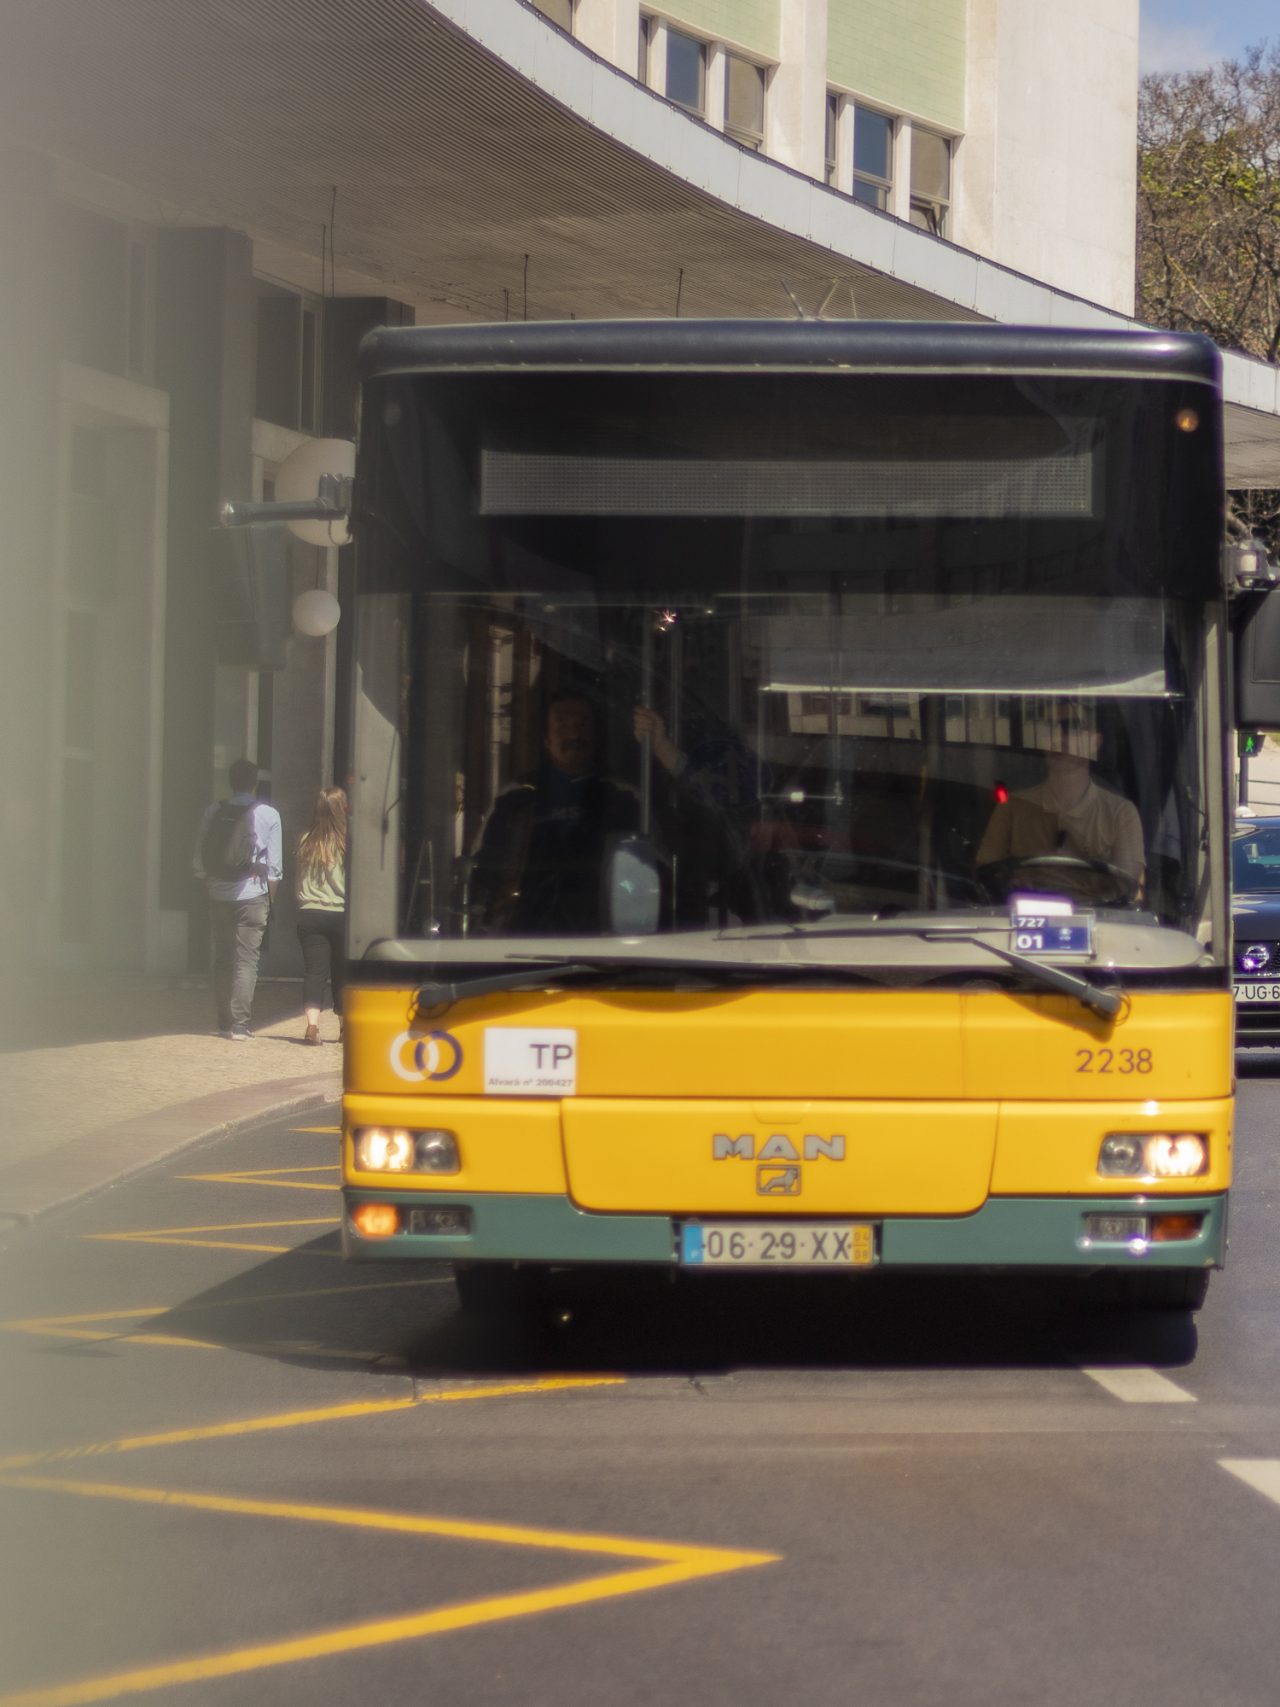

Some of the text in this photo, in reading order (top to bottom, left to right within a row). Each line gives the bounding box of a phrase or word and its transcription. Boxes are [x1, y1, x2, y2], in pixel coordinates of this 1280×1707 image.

[1017, 917, 1045, 928] 727
[1017, 934, 1043, 949] 01
[529, 1043, 573, 1070] TP
[1075, 1047, 1153, 1075] 2238
[712, 1133, 846, 1161] MAN
